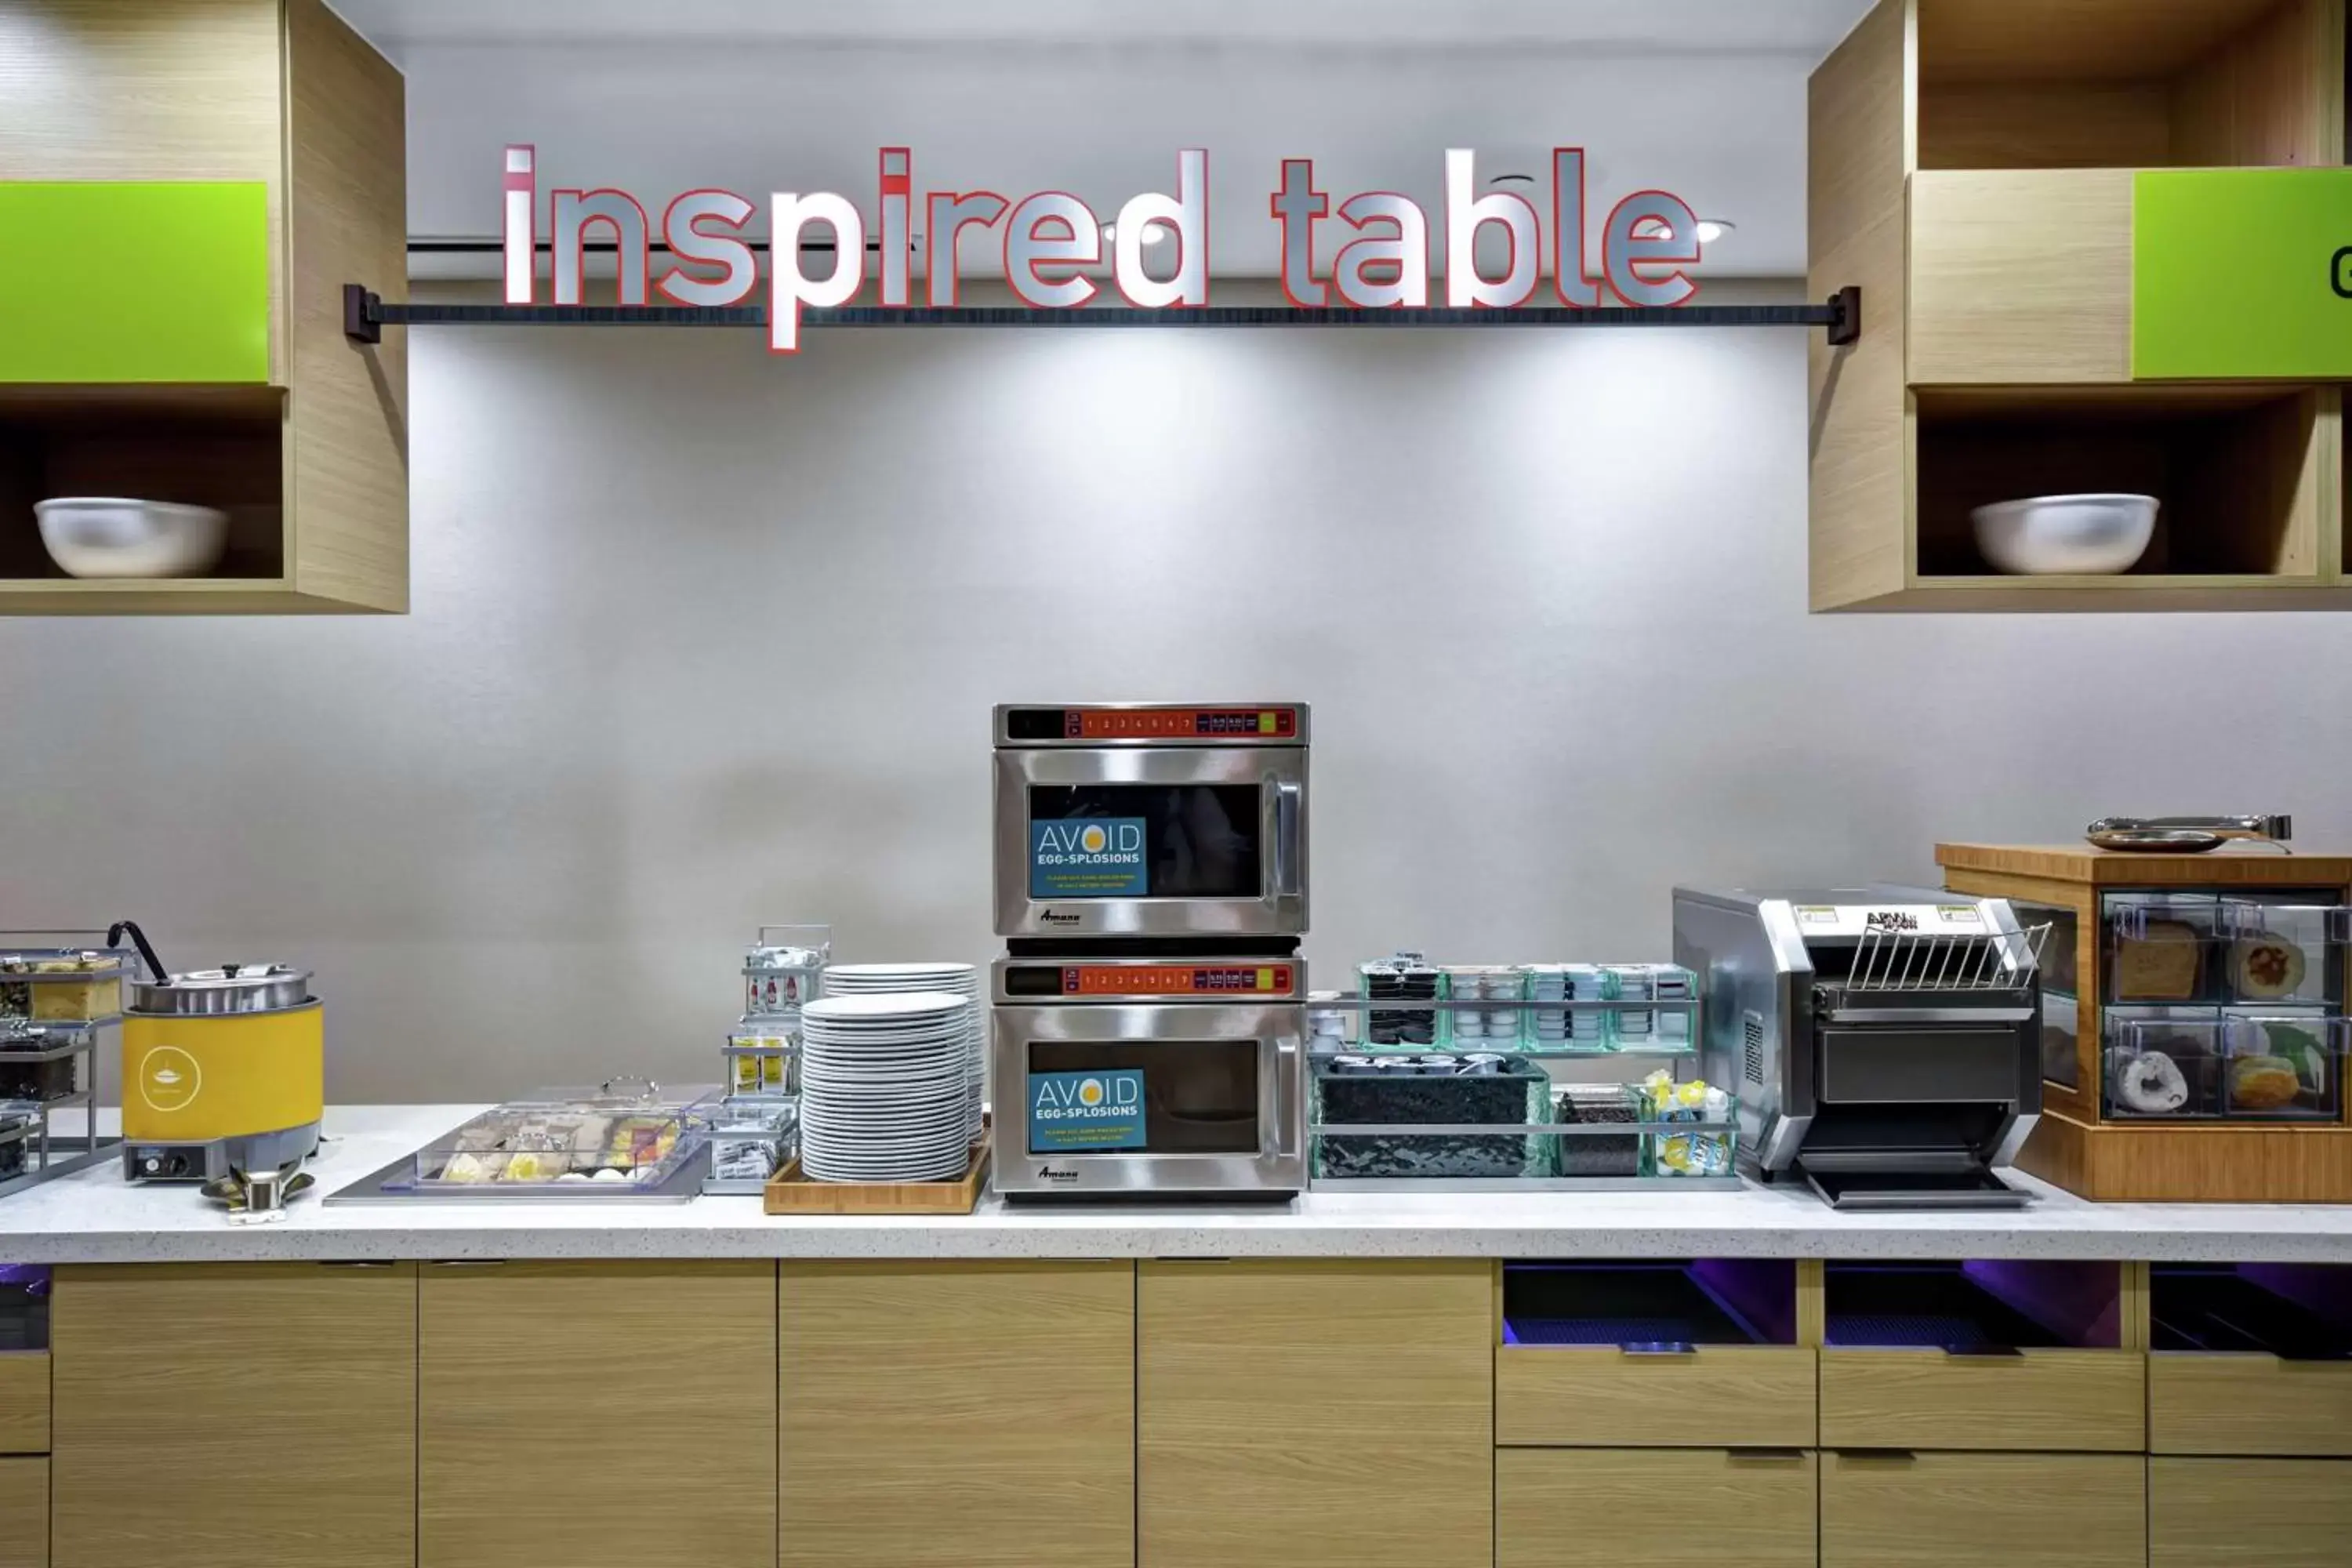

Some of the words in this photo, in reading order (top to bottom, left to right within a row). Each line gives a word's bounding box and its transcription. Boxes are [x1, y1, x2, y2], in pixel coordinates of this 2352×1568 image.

[502, 145, 1209, 355] inspired
[1270, 146, 1701, 309] table
[1038, 824, 1141, 853] AVOID
[1037, 853, 1140, 865] EGG-SPLOSIONS
[1036, 1076, 1138, 1107] AVOID
[1036, 1105, 1138, 1120] EGG-SPLOSIONS
